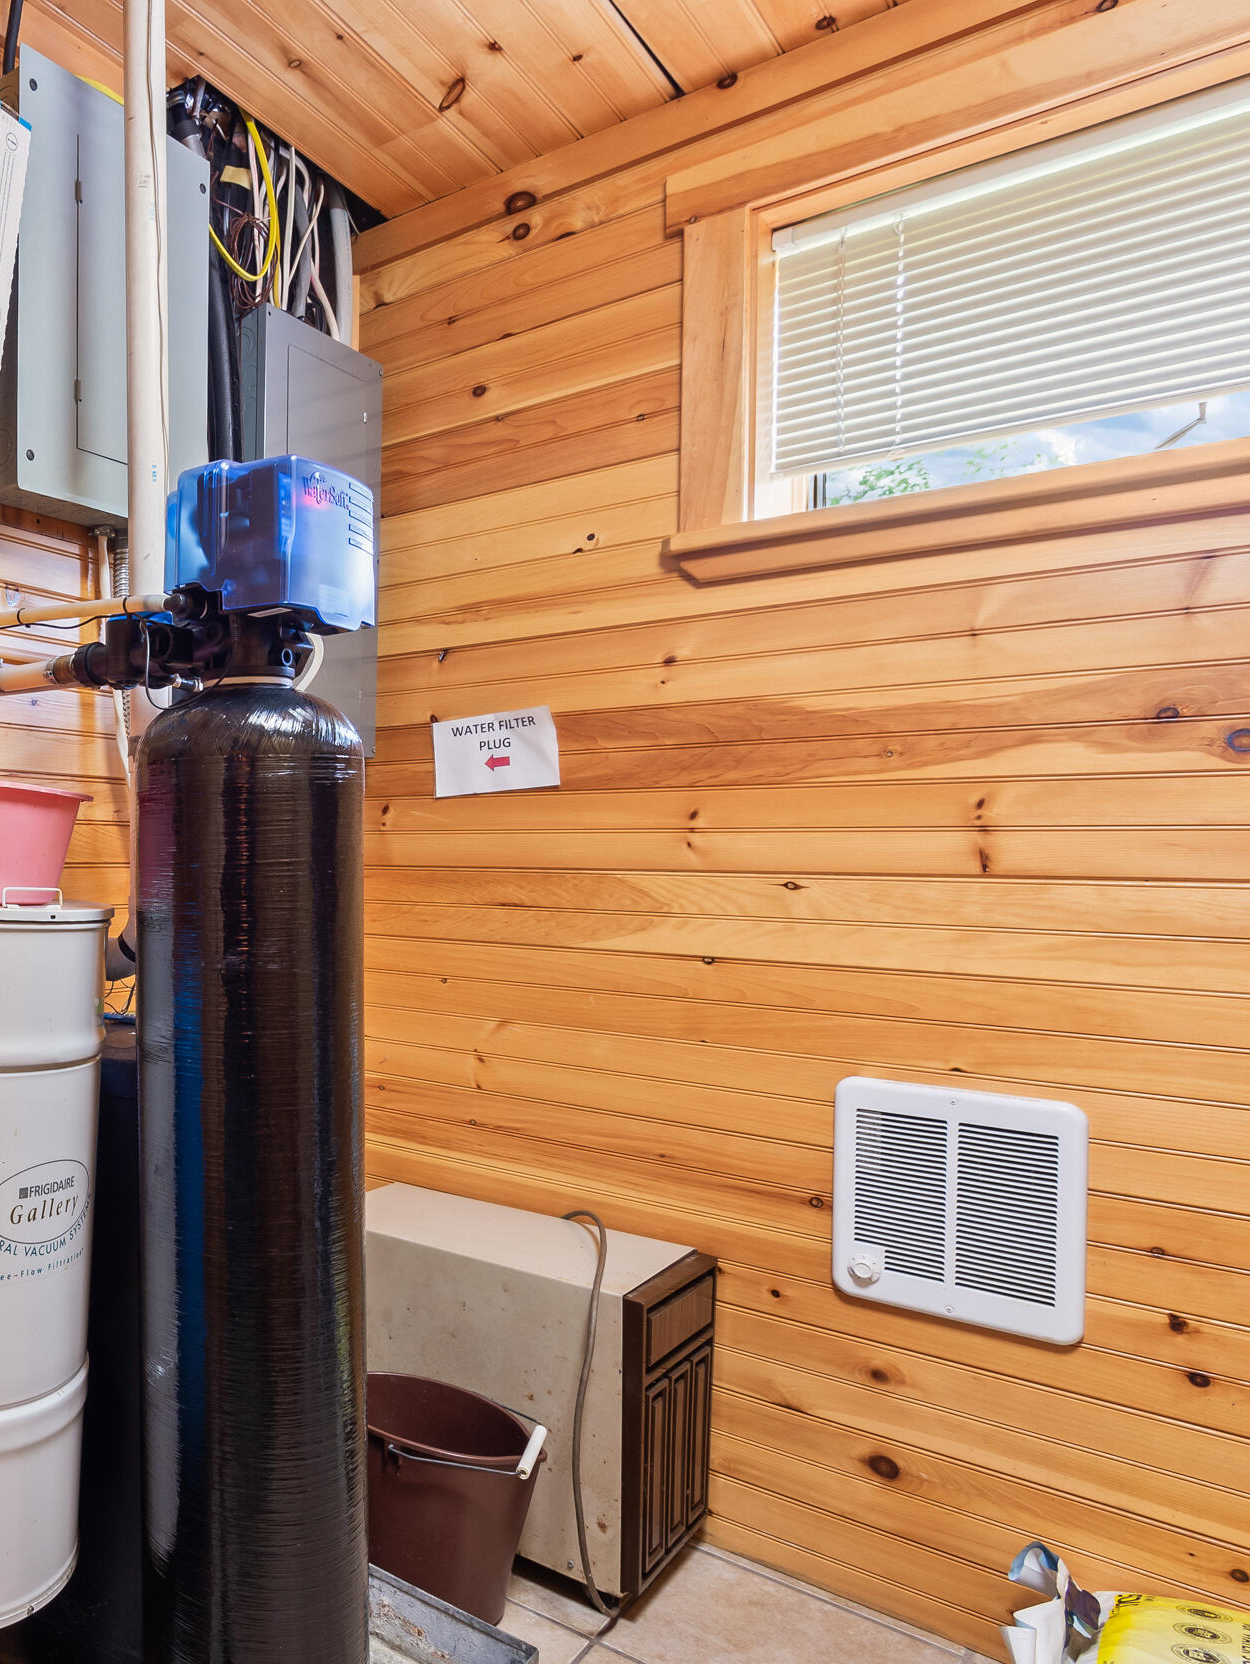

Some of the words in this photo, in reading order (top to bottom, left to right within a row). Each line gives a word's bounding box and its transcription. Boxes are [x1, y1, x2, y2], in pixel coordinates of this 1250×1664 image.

[451, 722, 495, 738] WATER
[498, 715, 536, 731] FILTER
[479, 737, 511, 751] PLUG
[29, 1175, 75, 1198] FRIGIDAIRE
[10, 1194, 79, 1225] Gallery
[24, 1237, 67, 1257] VACUUM
